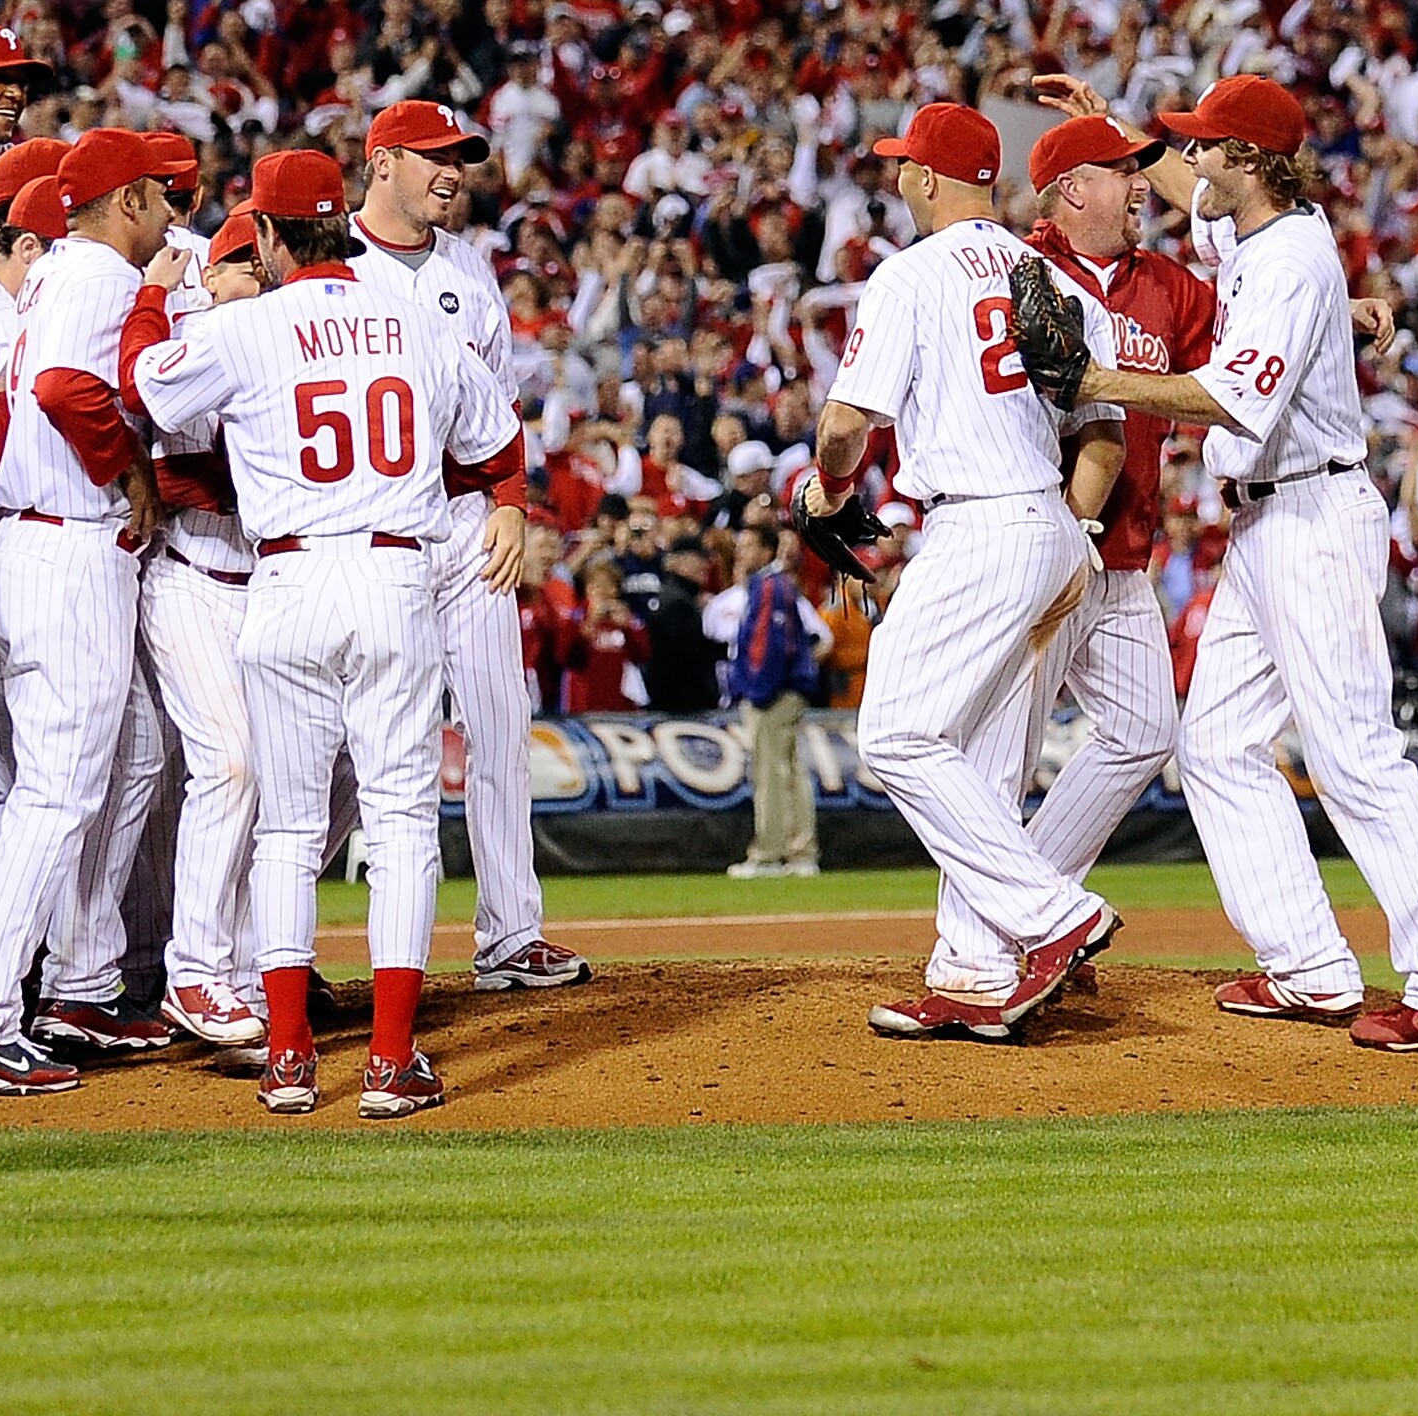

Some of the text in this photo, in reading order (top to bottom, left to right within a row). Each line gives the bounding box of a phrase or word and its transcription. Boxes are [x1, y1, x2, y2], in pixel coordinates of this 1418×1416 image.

[294, 317, 403, 363] MOYER
[1224, 348, 1286, 396] 28
[294, 375, 416, 484] 50
